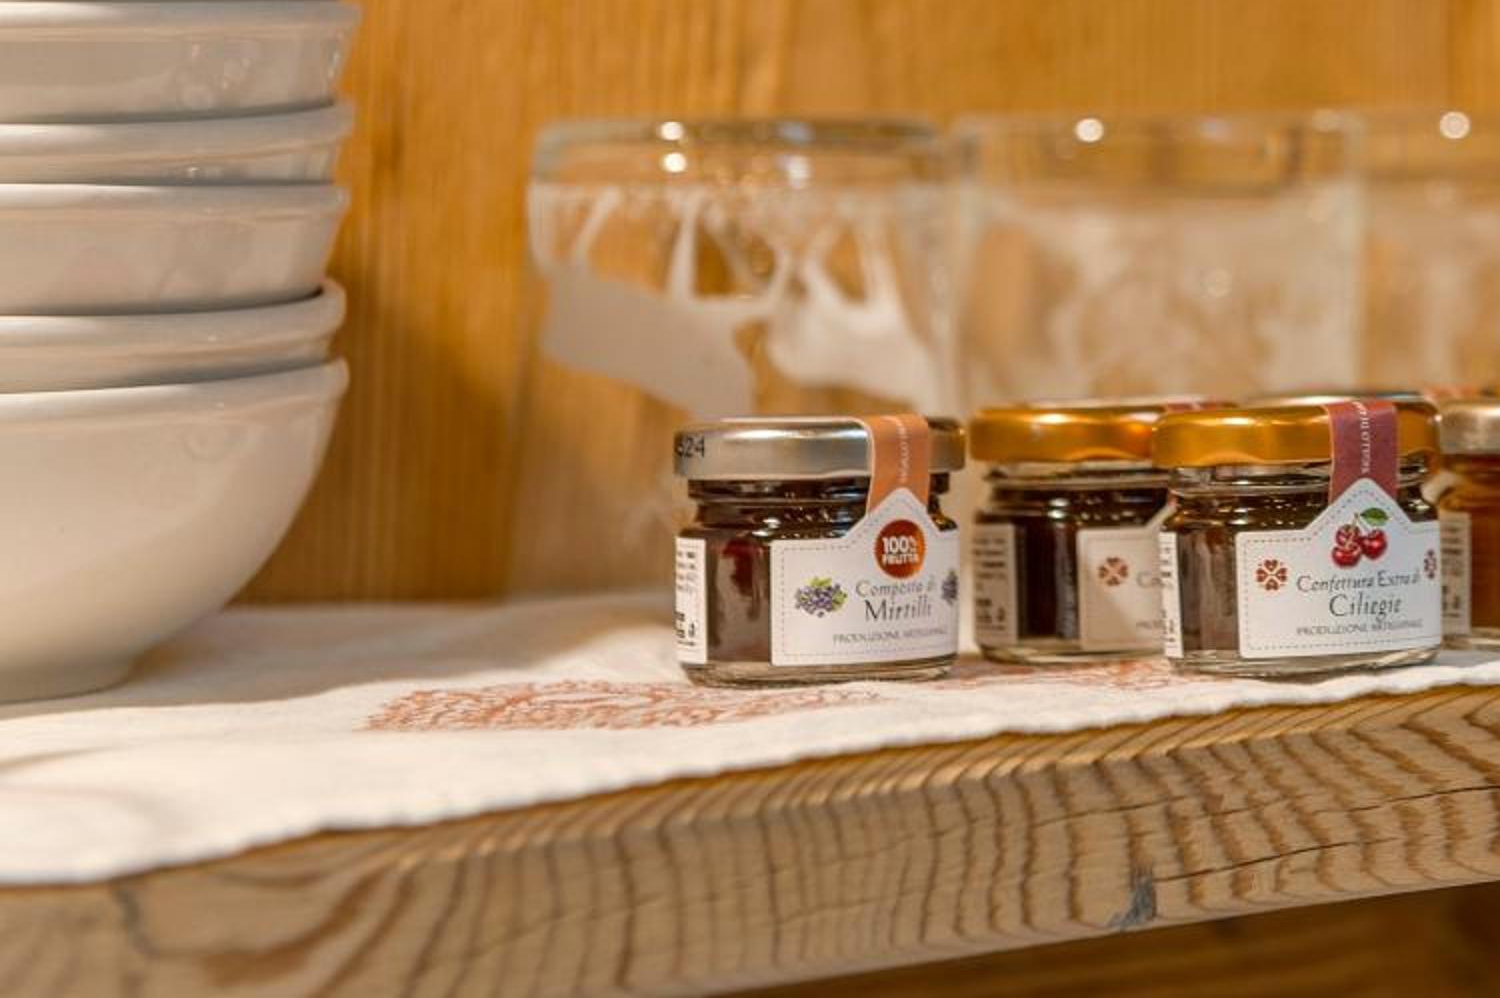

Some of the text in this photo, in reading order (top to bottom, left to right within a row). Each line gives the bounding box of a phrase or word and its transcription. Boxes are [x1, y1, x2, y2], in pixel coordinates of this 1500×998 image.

[1296, 574, 1374, 593] Confettura
[1376, 570, 1409, 587] Extra
[864, 594, 932, 621] Mirtilli
[1329, 592, 1402, 622] Ciliegie
